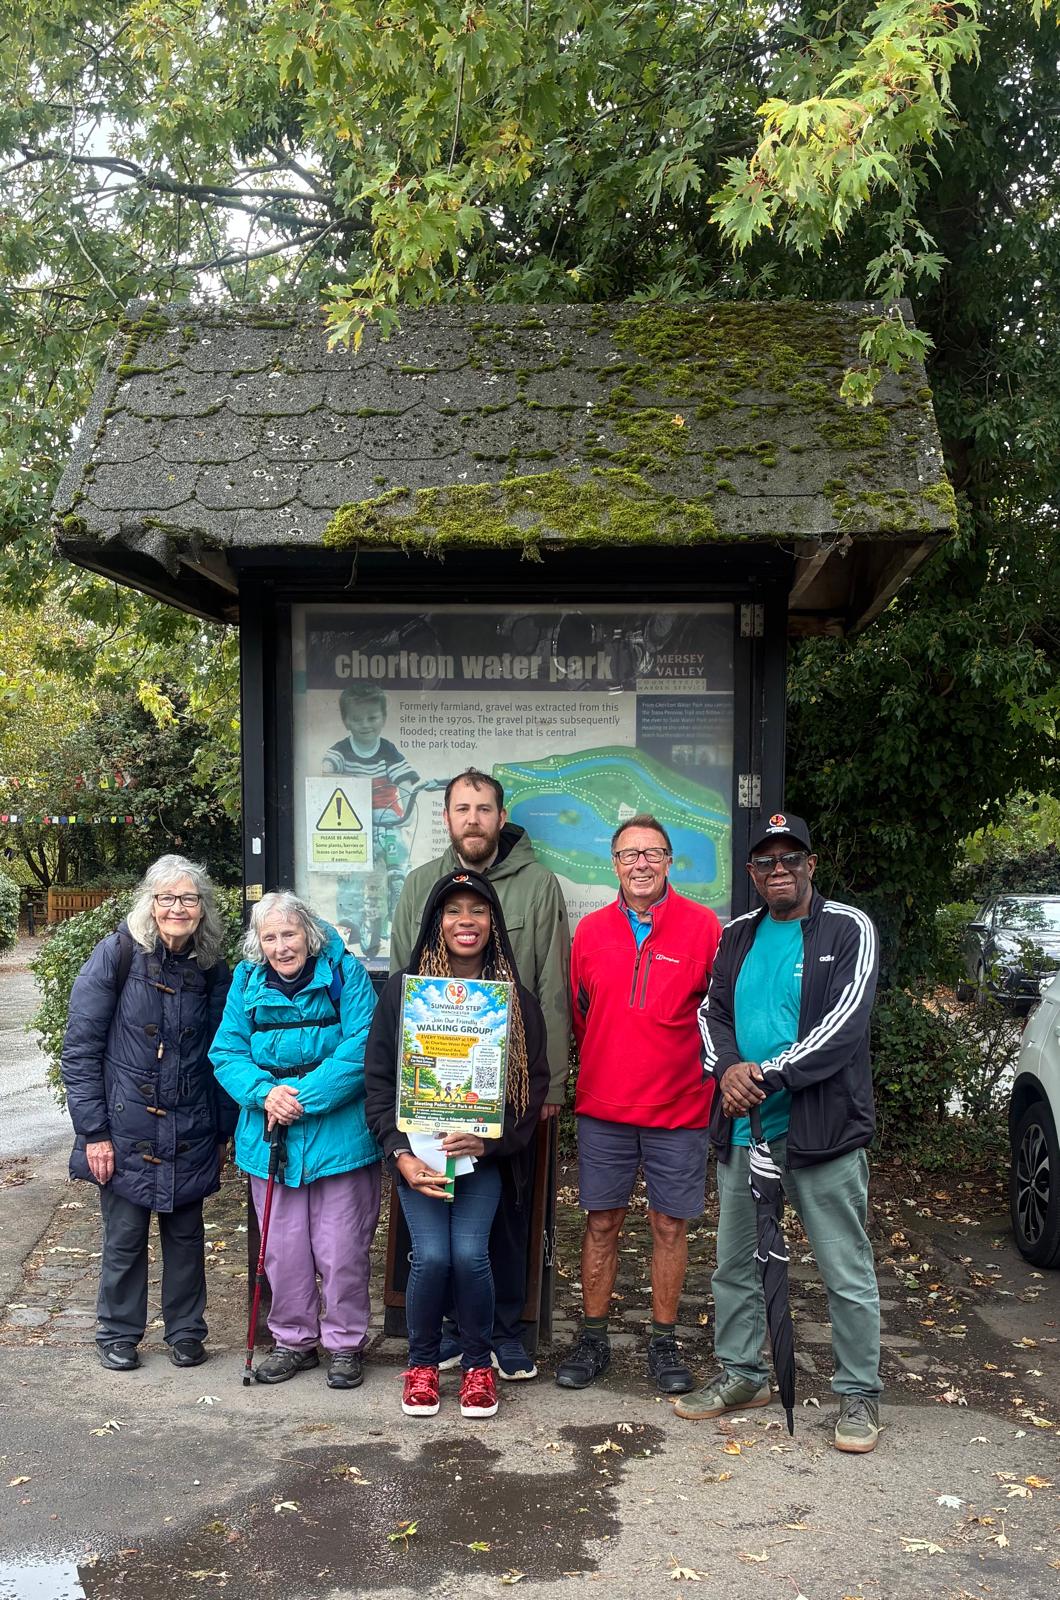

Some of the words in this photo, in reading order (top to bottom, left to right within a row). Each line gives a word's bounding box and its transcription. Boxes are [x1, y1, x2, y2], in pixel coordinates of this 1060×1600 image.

[656, 654, 705, 664] MERSEY
[334, 650, 454, 678] chorlton
[461, 653, 542, 679] water
[549, 651, 612, 682] park
[656, 666, 705, 676] VALLEY
[400, 702, 438, 712] Formerly
[440, 702, 482, 712] farmland,
[485, 702, 512, 713] gravel
[536, 703, 576, 712] extracted
[580, 702, 600, 712] from
[602, 702, 619, 712] this
[400, 714, 416, 723] site
[418, 714, 426, 723] in
[430, 714, 444, 724] the
[446, 716, 474, 726] 1970s.
[478, 714, 494, 724] The
[496, 715, 522, 726] gravel
[526, 715, 538, 726] pit
[560, 716, 620, 726] subsequently
[400, 727, 436, 736] flooded;
[440, 727, 474, 738] creating
[478, 728, 492, 736] the
[494, 728, 513, 736] lake
[516, 728, 534, 736] that
[536, 728, 544, 736] is
[546, 728, 576, 736] central
[400, 740, 409, 748] to
[412, 740, 426, 748] the
[428, 740, 450, 750] park
[451, 740, 478, 750] today.
[580, 900, 608, 909] people
[431, 1002, 464, 1011] SUNWARD
[416, 1024, 458, 1032] WALKING
[460, 1026, 493, 1035] GROUP!
